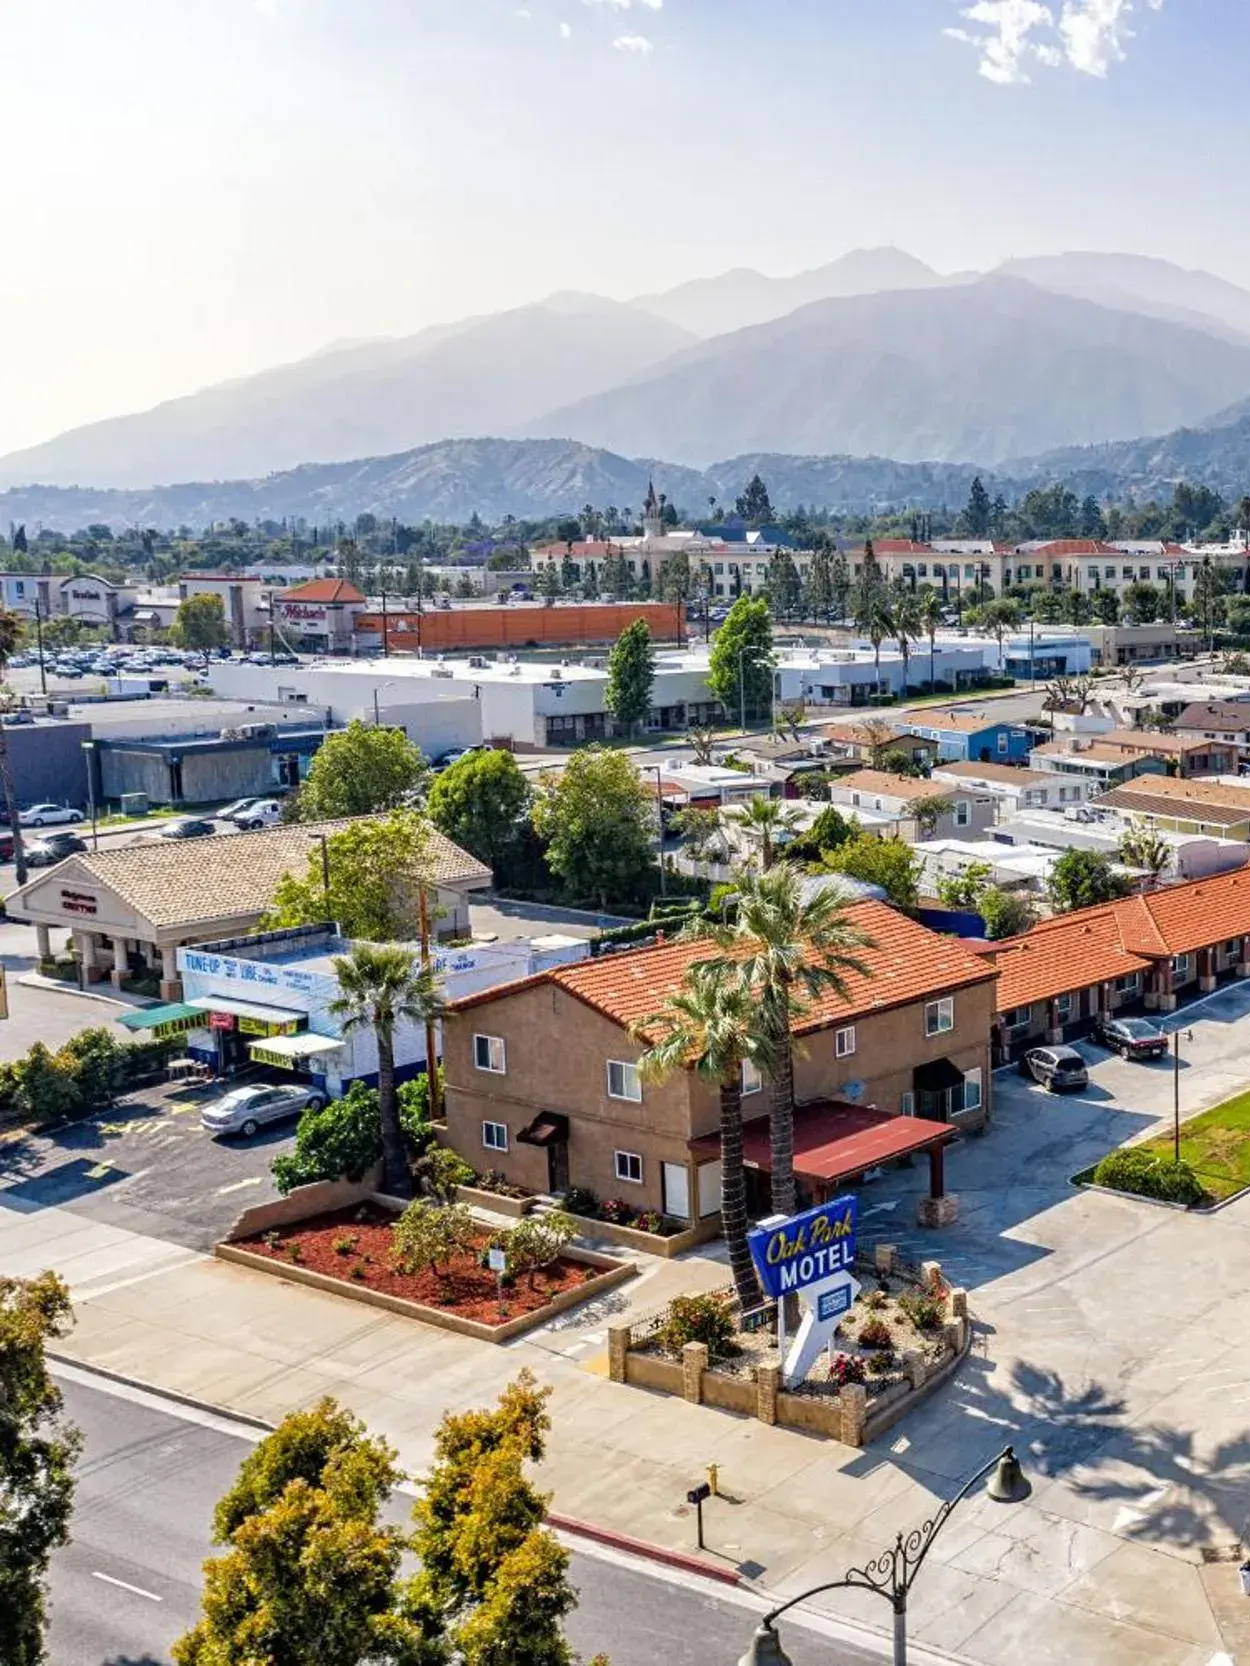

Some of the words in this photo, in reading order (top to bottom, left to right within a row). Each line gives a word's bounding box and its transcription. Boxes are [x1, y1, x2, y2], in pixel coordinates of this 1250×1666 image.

[186, 954, 220, 973] TUNE-UP
[767, 1226, 805, 1265] Oak
[810, 1208, 852, 1248] Park
[780, 1240, 855, 1291] MOTEL
